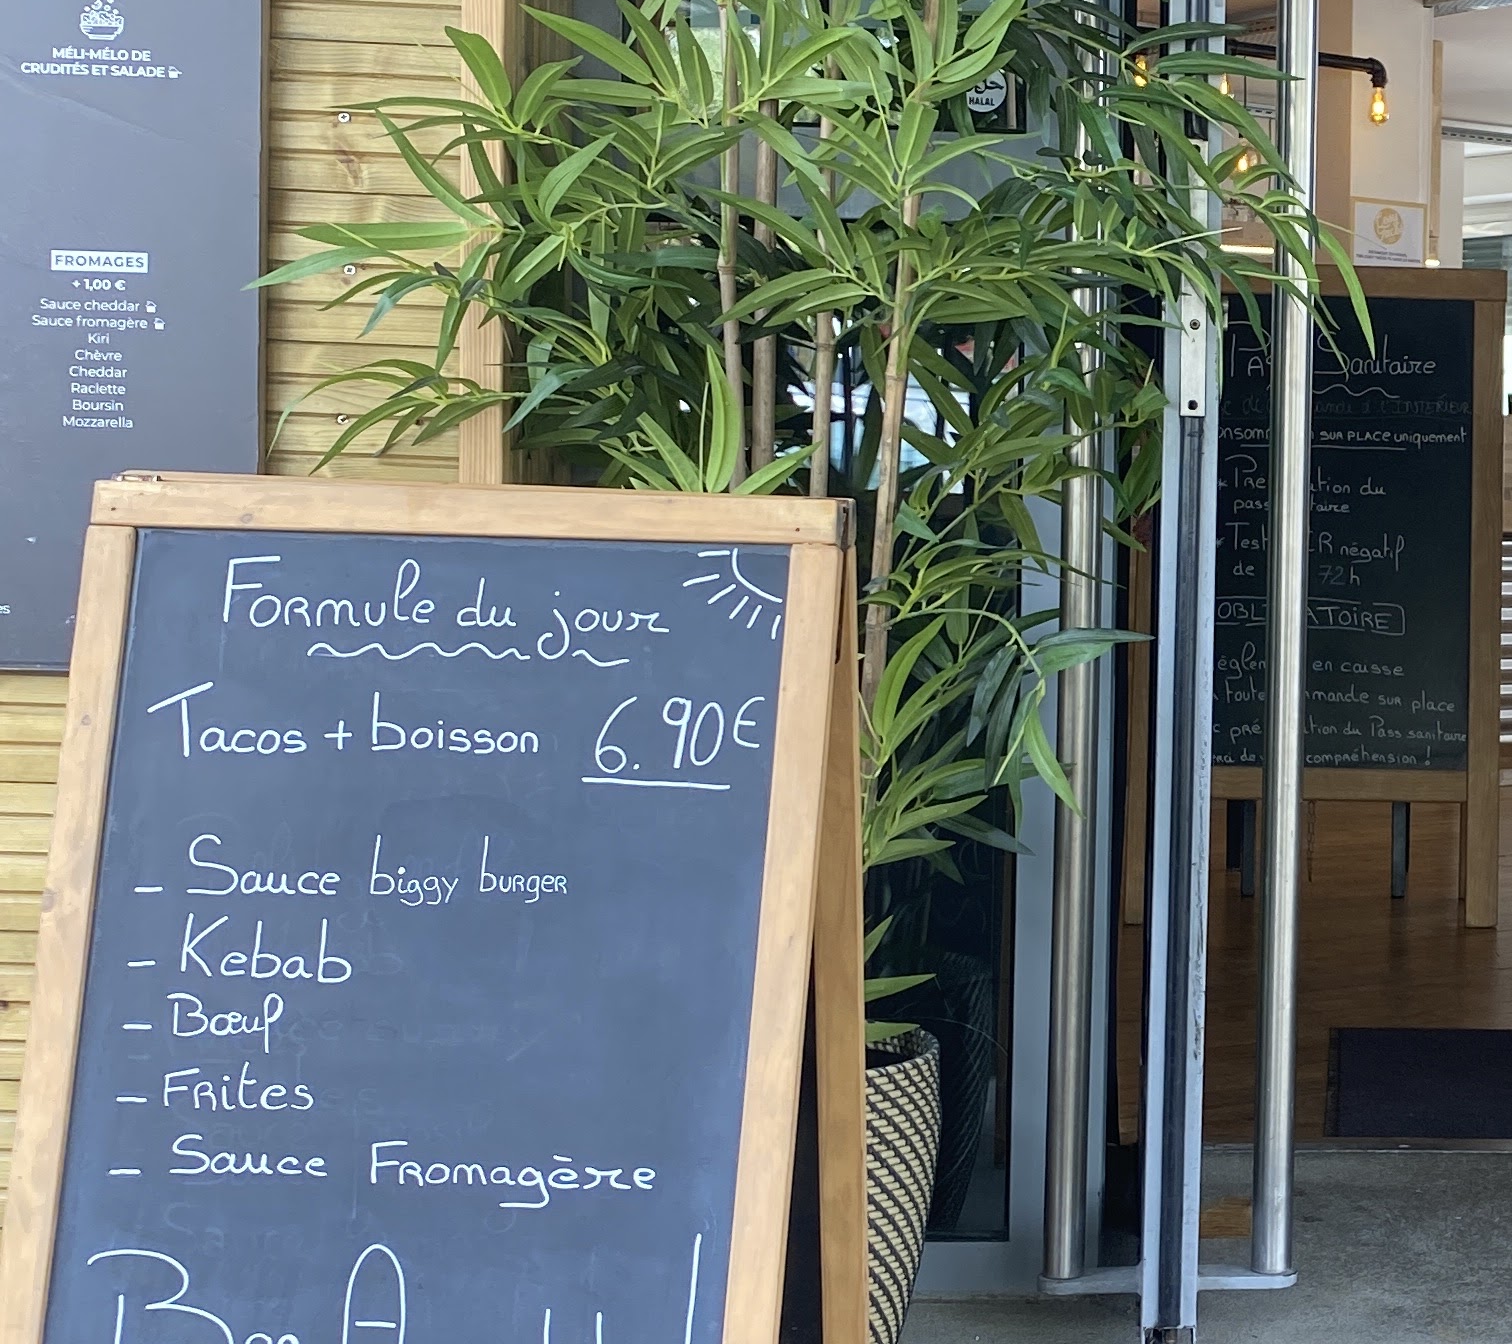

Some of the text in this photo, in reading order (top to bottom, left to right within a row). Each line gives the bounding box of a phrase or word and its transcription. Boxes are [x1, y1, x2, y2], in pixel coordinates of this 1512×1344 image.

[52, 45, 152, 62] MÉLI-MÉLO DE
[20, 61, 166, 78] CRUDITÉS ET SALADE
[968, 96, 995, 106] HALAL
[54, 254, 145, 268] FROMAGES
[83, 278, 112, 292] 1,00
[114, 279, 126, 291] €
[40, 297, 141, 312] Sauce cheddar
[31, 314, 149, 331] Sauce fromagère
[88, 332, 110, 344] Kiri
[74, 348, 123, 361] Chèvre
[69, 365, 128, 378] Cheddar
[70, 382, 126, 395] Raclette
[72, 398, 124, 411] Boursin
[62, 415, 134, 429] Mozzarella
[1360, 477, 1387, 496] du
[222, 556, 670, 660] Formule du jour
[1312, 659, 1333, 672] en
[1341, 662, 1405, 677] caisse
[1412, 689, 1456, 714] place
[147, 681, 308, 757] Tacos
[323, 720, 352, 748] +
[371, 691, 539, 754] boisson
[1343, 721, 1362, 736] du
[1368, 715, 1403, 739] Pass
[186, 833, 340, 896] Sauce
[370, 834, 459, 906] biggy
[479, 835, 568, 904] burger
[178, 912, 353, 985] Kebab
[162, 1061, 315, 1111] Frites
[169, 1133, 328, 1179] Sauce
[369, 1139, 657, 1208] Fromagère
